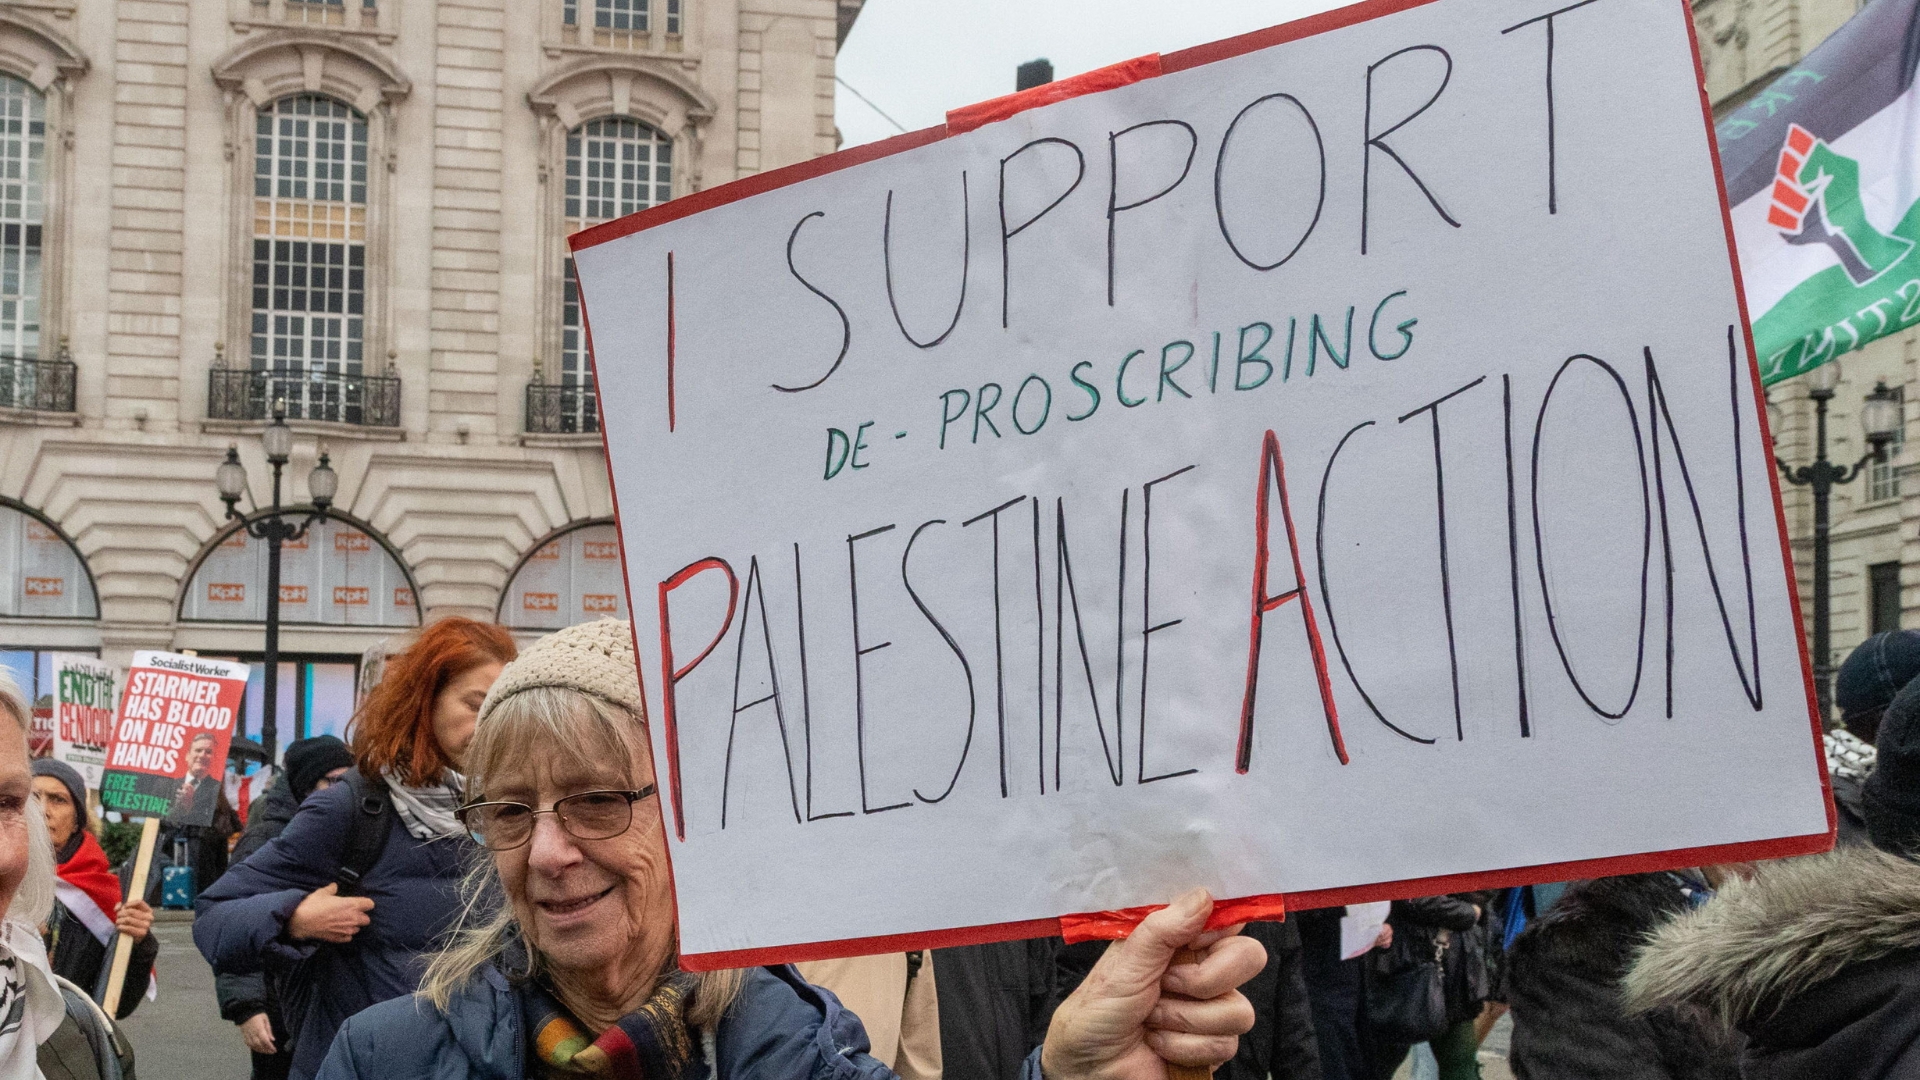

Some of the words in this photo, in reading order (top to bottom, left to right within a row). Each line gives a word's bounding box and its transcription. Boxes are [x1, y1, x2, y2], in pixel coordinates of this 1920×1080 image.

[666, 249, 677, 433] I
[769, 0, 1596, 393] SUPPORT
[658, 464, 1200, 843] PALESTINE
[1235, 325, 1763, 775] ACTION
[131, 671, 221, 705] STARMER
[124, 694, 164, 721] HAS
[166, 700, 232, 730] BLOOD
[119, 719, 148, 743] ON
[150, 722, 187, 749] HIS
[111, 742, 179, 774] HANDS
[104, 773, 138, 792] FREE
[102, 790, 172, 816] PALESTINE
